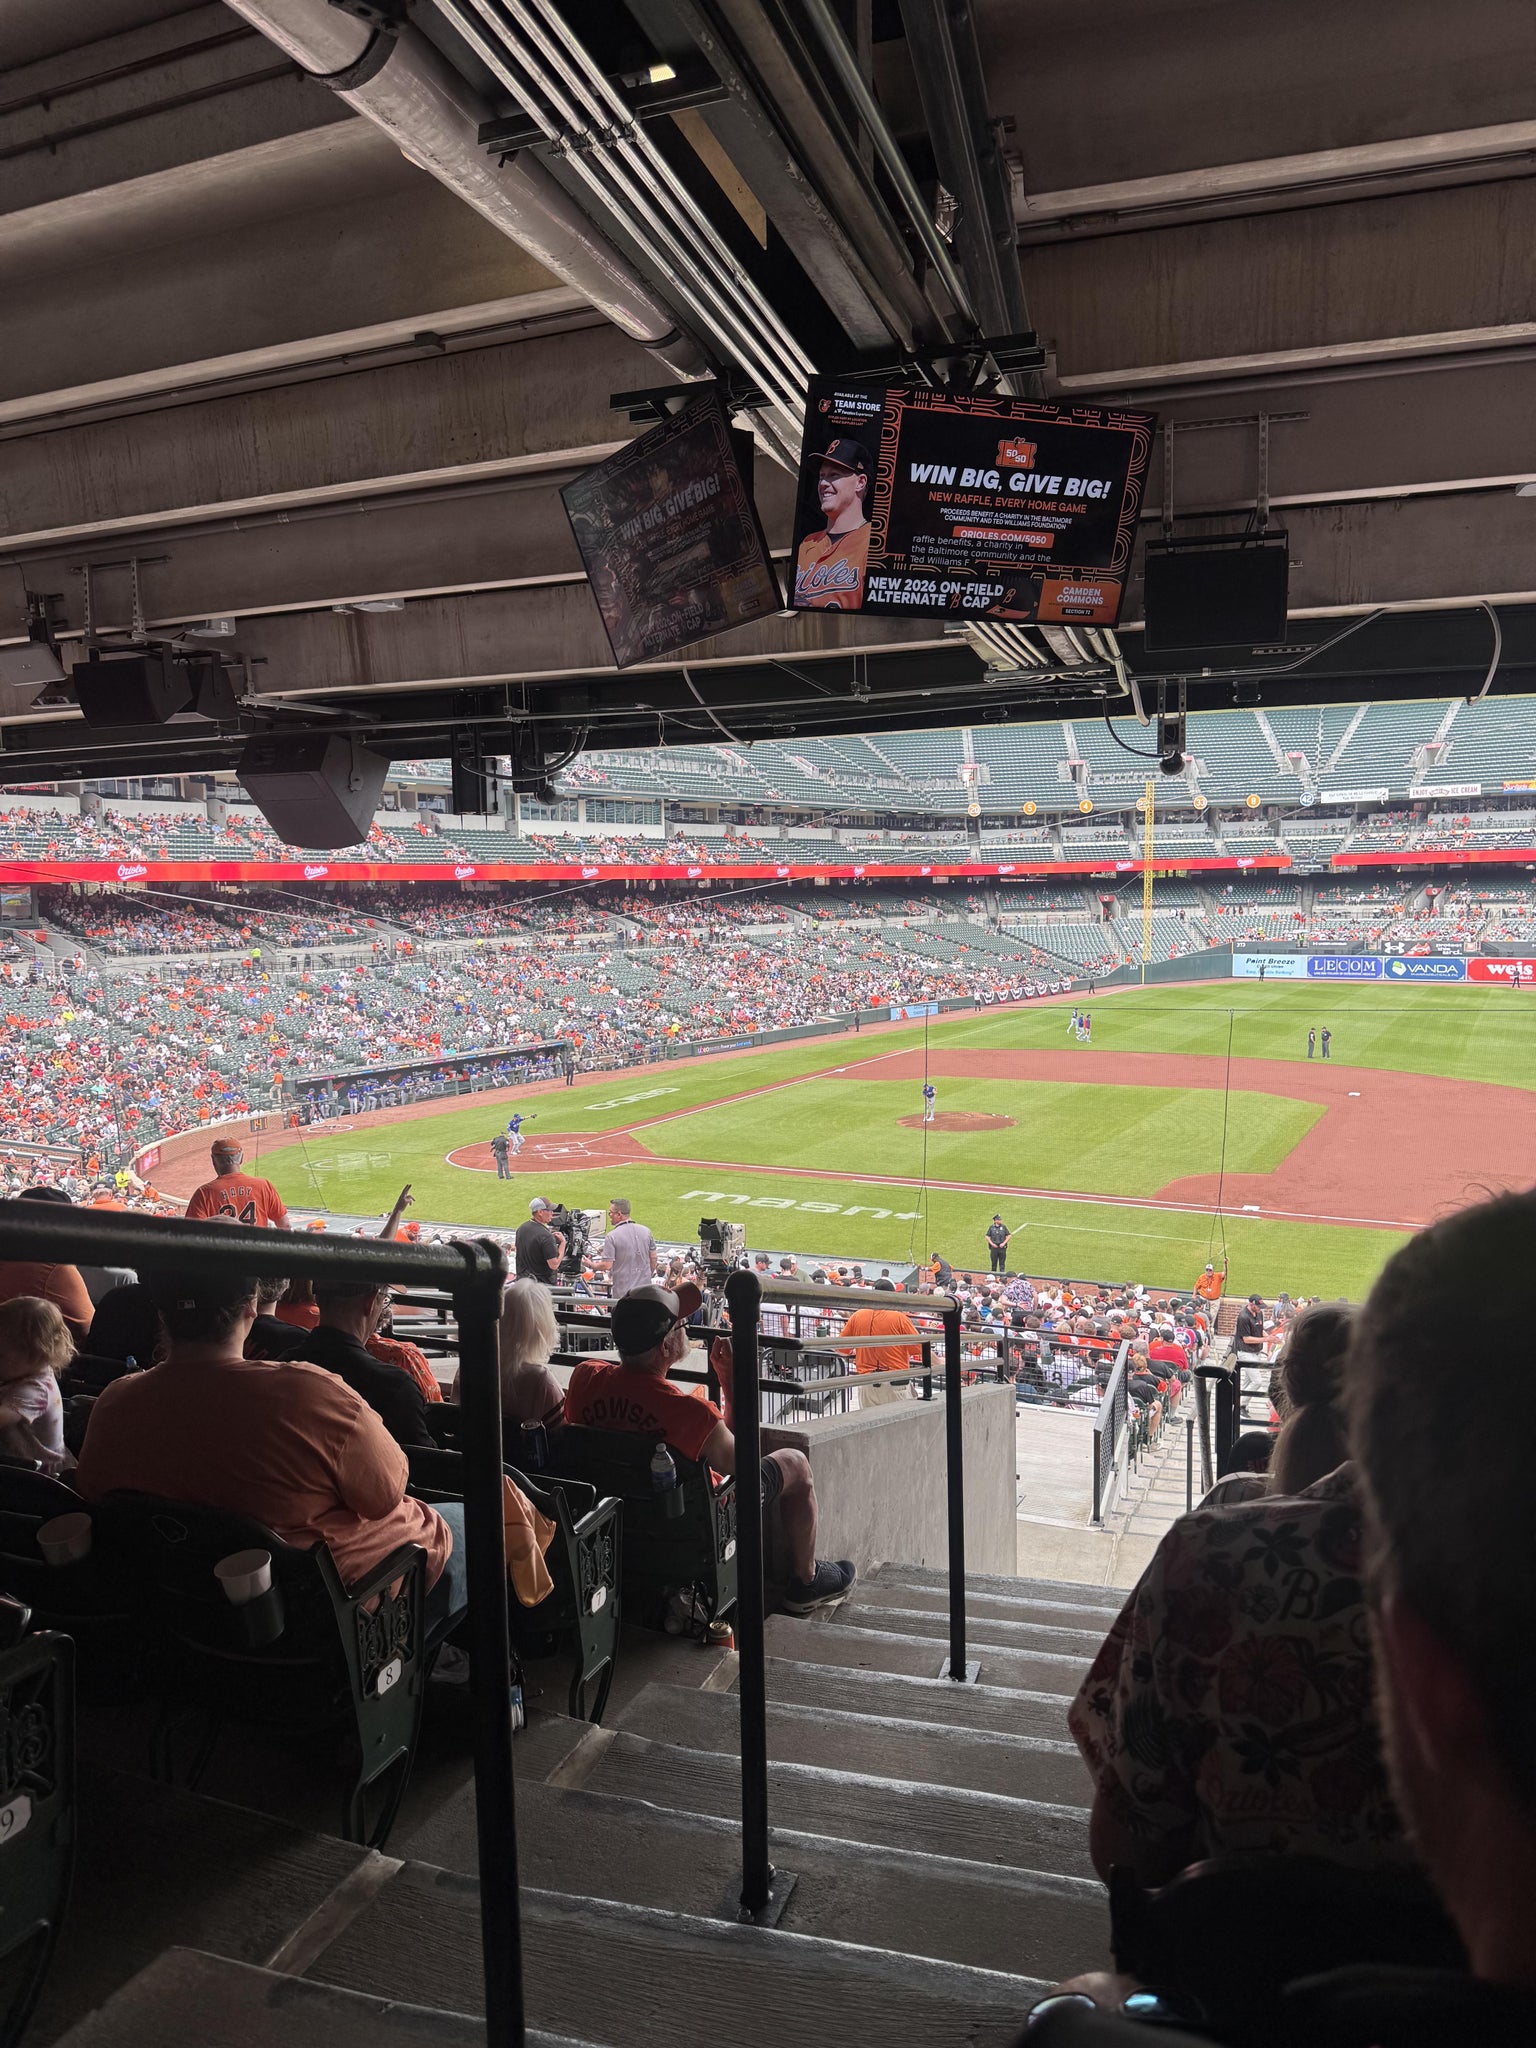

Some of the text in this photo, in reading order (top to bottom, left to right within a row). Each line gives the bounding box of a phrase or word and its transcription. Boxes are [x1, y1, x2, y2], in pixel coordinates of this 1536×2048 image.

[835, 400, 881, 412] TEAM STORE
[911, 463, 1112, 500] WIN BIG, GIVE BIG!
[620, 515, 644, 541] WIN
[666, 488, 696, 517] GIVE
[693, 472, 722, 504] BIG!
[929, 491, 1087, 514] NEW RAFFLE, EVERY HOME GAME
[944, 515, 979, 523] COMMUNITY
[1004, 519, 1030, 527] WILLIAMS
[1031, 521, 1066, 530] FOUNDATION
[999, 512, 1023, 520] CHARITY
[1041, 516, 1072, 524] BALTIMORE
[913, 535, 935, 544] raffle
[938, 537, 973, 547] benefits,
[984, 540, 1012, 551] charity
[1015, 542, 1023, 550] in
[960, 530, 1047, 544] ORIOLES.COM/5050
[910, 555, 925, 564] Ted
[927, 555, 962, 566] Williams
[911, 545, 926, 553] the
[928, 546, 968, 556] Baltimore
[970, 549, 1018, 561] community
[1038, 554, 1051, 562] the
[868, 576, 1004, 597] NEW 2026 ON-FIELD
[1062, 586, 1102, 596] CAMDEN
[867, 590, 947, 606] ALTERNATE
[962, 595, 990, 608] CAP
[1056, 594, 1104, 605] COMMONS
[1461, 786, 1478, 794] CREAM
[117, 864, 148, 880] Orioles
[304, 864, 329, 879] Orioles
[1314, 959, 1376, 971] LECOM
[1406, 963, 1458, 973] VANDA
[1486, 961, 1534, 976] weis
[221, 1186, 252, 1200] HAGY
[678, 1190, 925, 1220] masn+
[596, 1592, 602, 1606] 7
[386, 1667, 393, 1686] 8
[2, 1809, 14, 1836] 9
